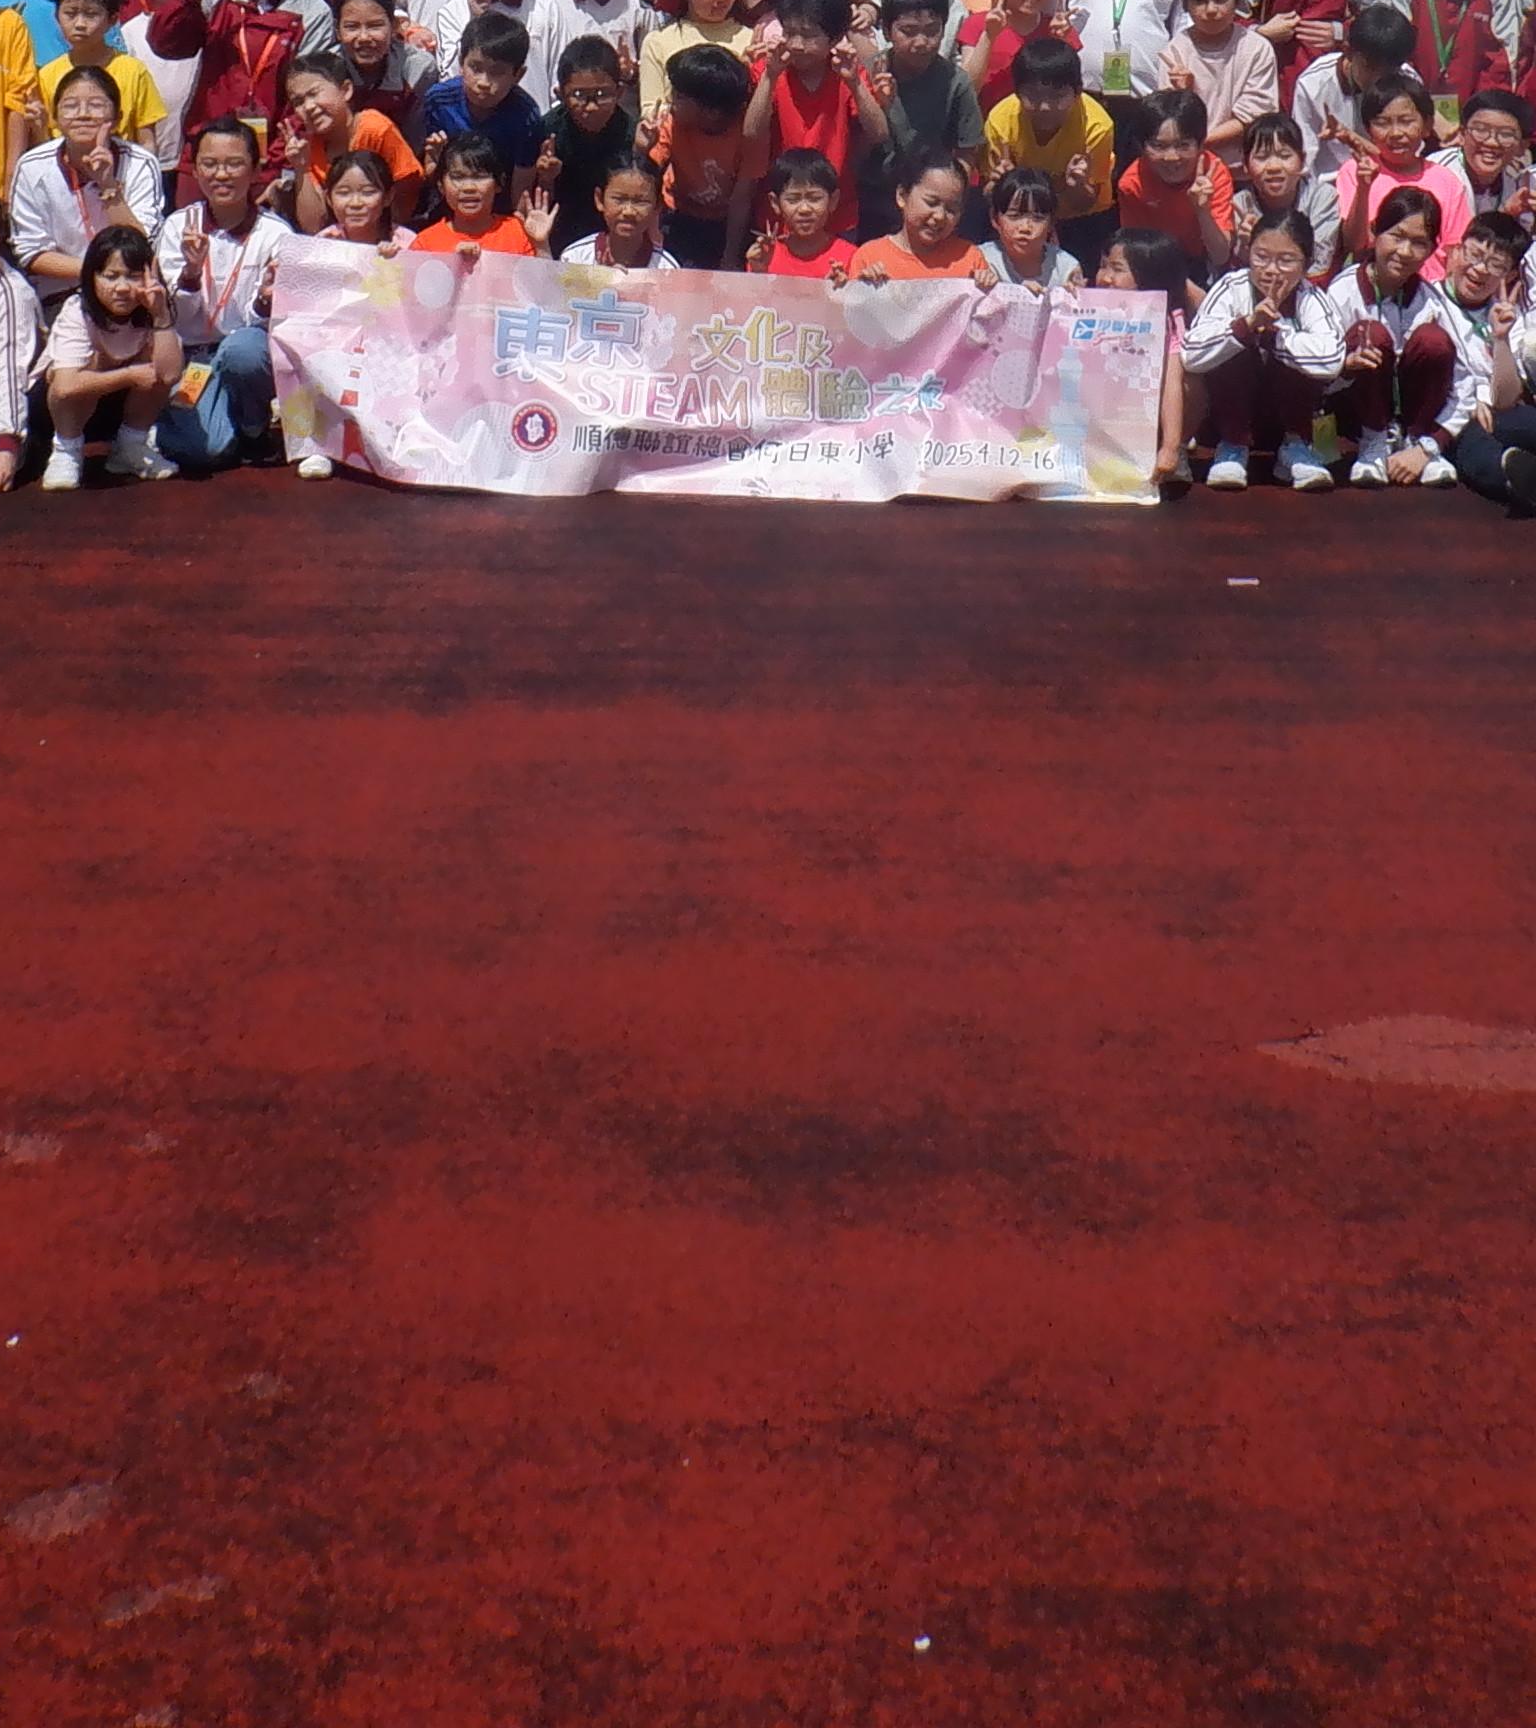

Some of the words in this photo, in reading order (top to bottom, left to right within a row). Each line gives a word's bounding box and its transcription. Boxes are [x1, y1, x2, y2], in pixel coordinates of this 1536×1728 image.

[495, 290, 648, 381] 東京
[692, 309, 833, 371] 文化及
[577, 371, 751, 428] STEAM
